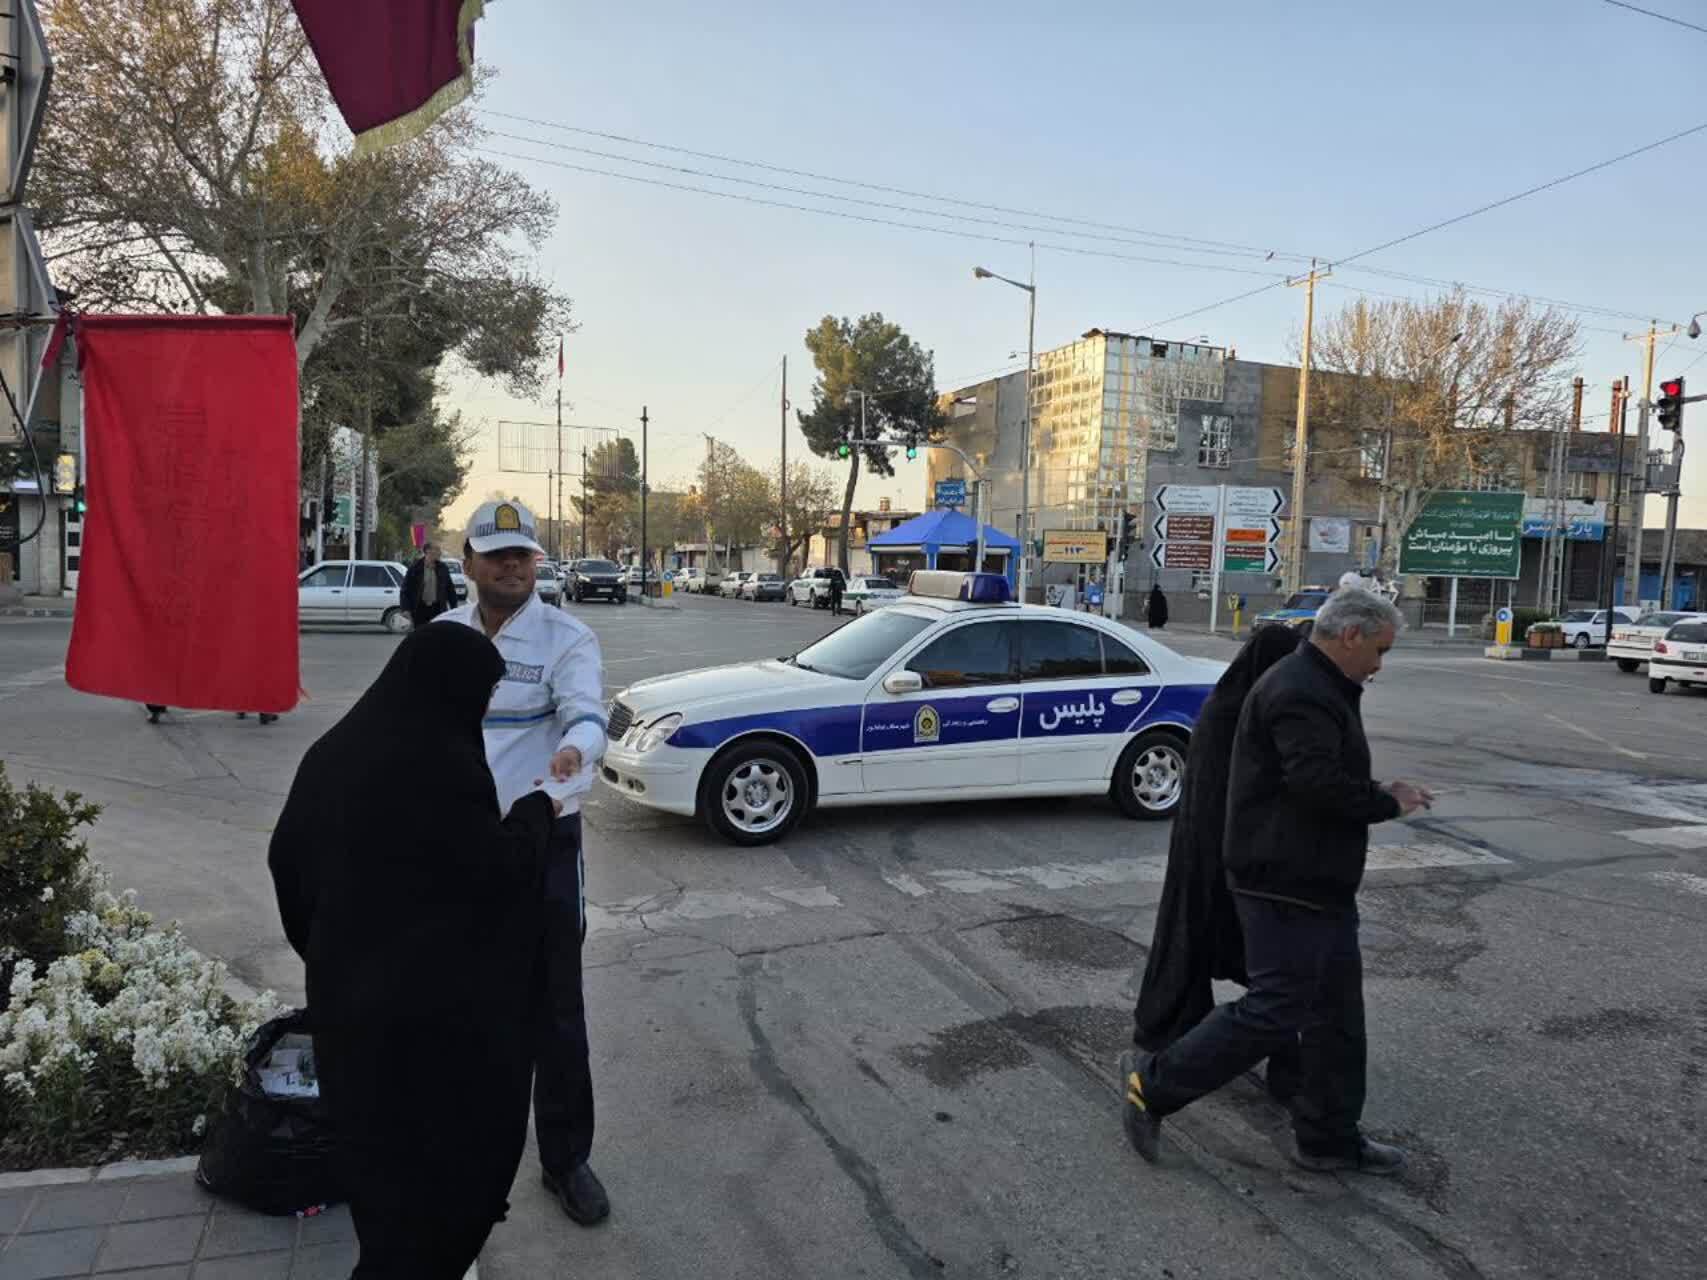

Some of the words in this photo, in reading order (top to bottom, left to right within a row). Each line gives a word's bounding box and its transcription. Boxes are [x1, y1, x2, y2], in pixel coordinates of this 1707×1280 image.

[1408, 541, 1432, 550] است
[1468, 542, 1478, 554] با
[1478, 544, 1513, 555] پیروزی
[1039, 693, 1106, 730] پلیس
